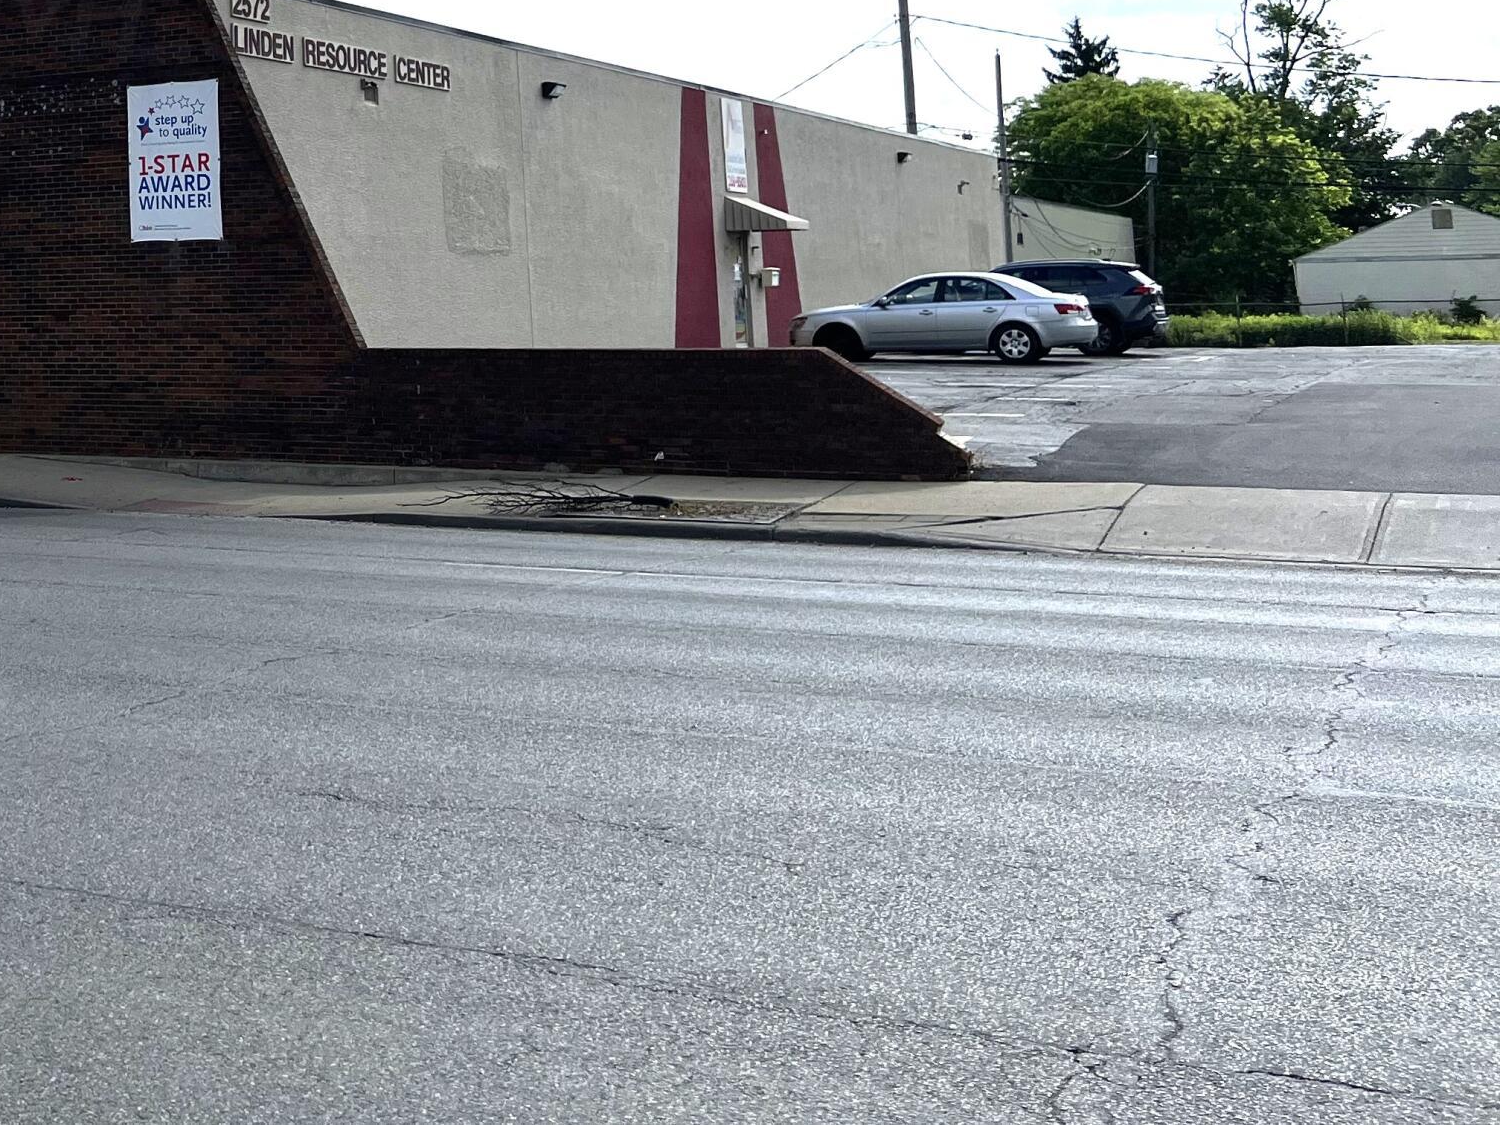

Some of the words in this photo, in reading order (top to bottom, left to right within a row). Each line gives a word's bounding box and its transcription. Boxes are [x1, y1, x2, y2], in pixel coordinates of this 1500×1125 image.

[234, 24, 294, 61] LINDEN
[305, 38, 388, 77] RESOURCE
[397, 56, 450, 89] CENTER
[155, 115, 177, 126] step
[181, 115, 194, 125] up
[159, 127, 169, 137] to
[172, 124, 207, 139] quality
[138, 153, 210, 176] 1-STAR
[138, 173, 211, 194] AWARD
[138, 192, 212, 210] WINNER!
